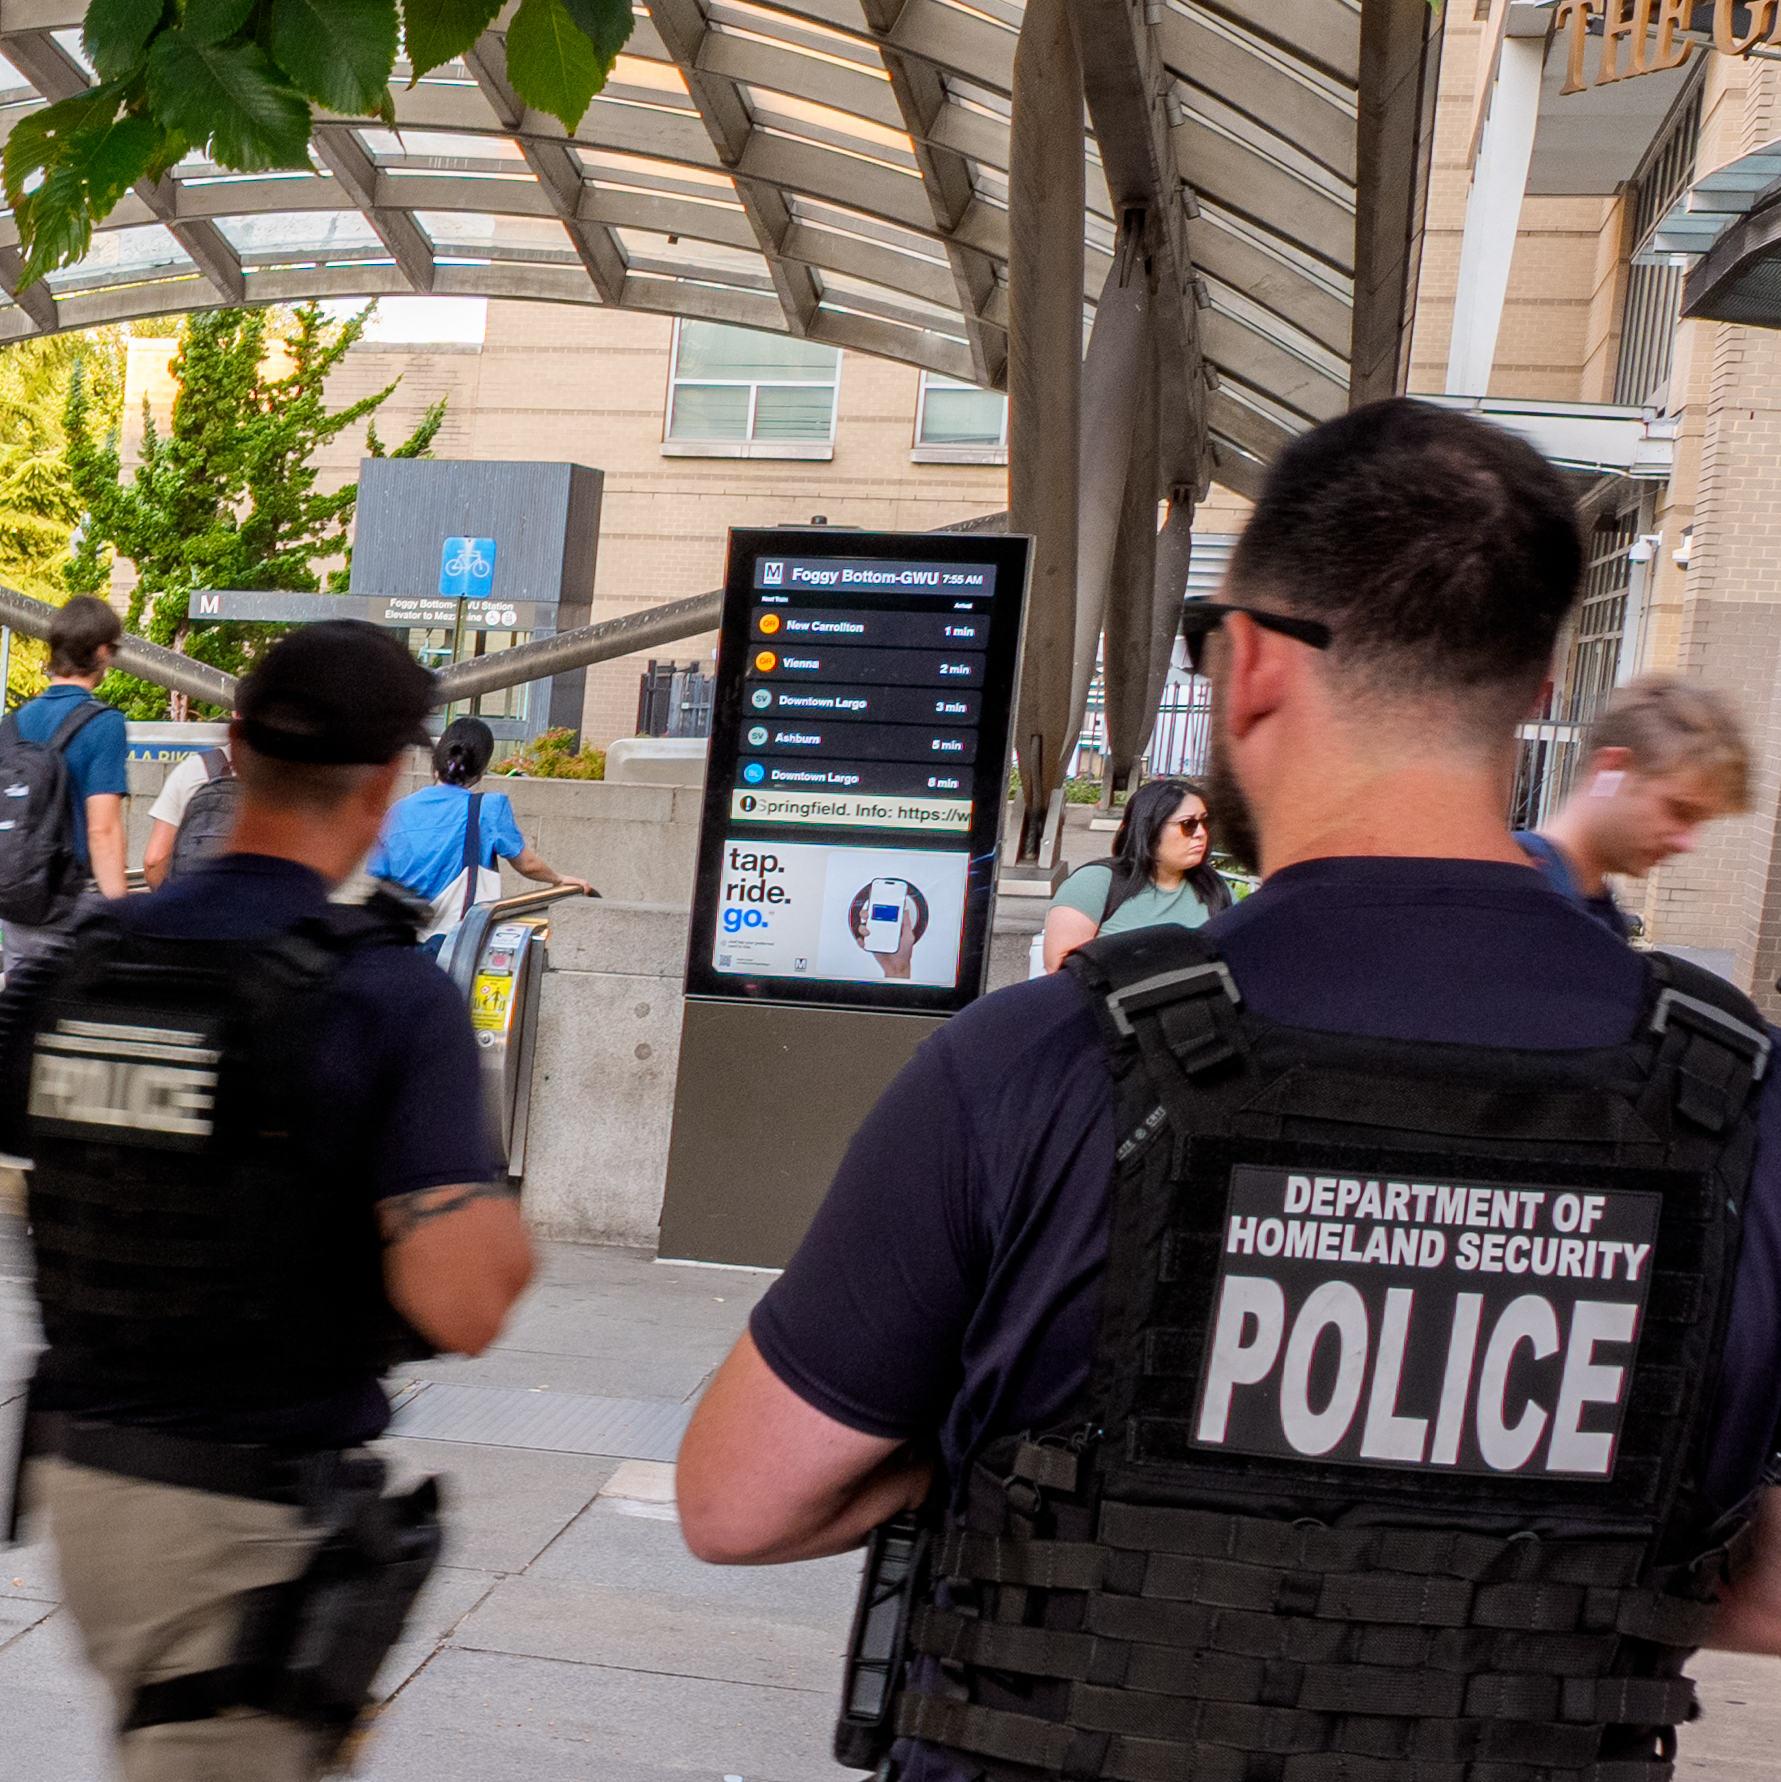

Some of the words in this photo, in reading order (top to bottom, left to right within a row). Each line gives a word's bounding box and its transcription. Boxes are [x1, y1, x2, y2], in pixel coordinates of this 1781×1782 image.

[1556, 0, 1695, 96] THE
[1713, 0, 1781, 56] G
[792, 568, 839, 584] Foggy
[842, 569, 939, 585] Bottom-GWU
[942, 574, 964, 584] 7:55
[965, 575, 983, 585] AM
[200, 594, 219, 614] M
[390, 598, 418, 609] Foggy
[420, 599, 479, 611] Bottom-WU
[481, 601, 514, 611] Station
[385, 610, 421, 619] Elevator
[423, 611, 431, 619] to
[763, 619, 776, 628] OR
[787, 620, 809, 631] New
[811, 621, 864, 633] Carrollton
[944, 626, 951, 636] 1
[953, 626, 975, 637] min
[759, 657, 773, 665] OR
[783, 658, 819, 669] Vienna
[940, 663, 948, 674] 2
[949, 664, 970, 675] min
[755, 695, 768, 703] SV
[779, 695, 833, 707] Downtown
[836, 698, 867, 711] Largo
[935, 702, 944, 713] 3
[946, 702, 967, 713] min
[752, 732, 764, 740] SV
[775, 733, 821, 745] Ashburn
[941, 740, 963, 750] min
[771, 770, 825, 782] Downtown
[828, 772, 859, 785] Largo
[927, 777, 935, 788] 8
[937, 778, 958, 789] min
[758, 799, 850, 817] Springfield.
[856, 804, 892, 818] Info:
[729, 848, 785, 878] tap.
[726, 878, 791, 904] ride.
[723, 907, 768, 933] go.
[1283, 1174, 1545, 1230] DEPARTMENT
[1551, 1193, 1606, 1234] OF
[1225, 1215, 1446, 1268] HOMELAND
[1454, 1232, 1650, 1281] SECURITY
[1197, 1274, 1638, 1474] POLICE
